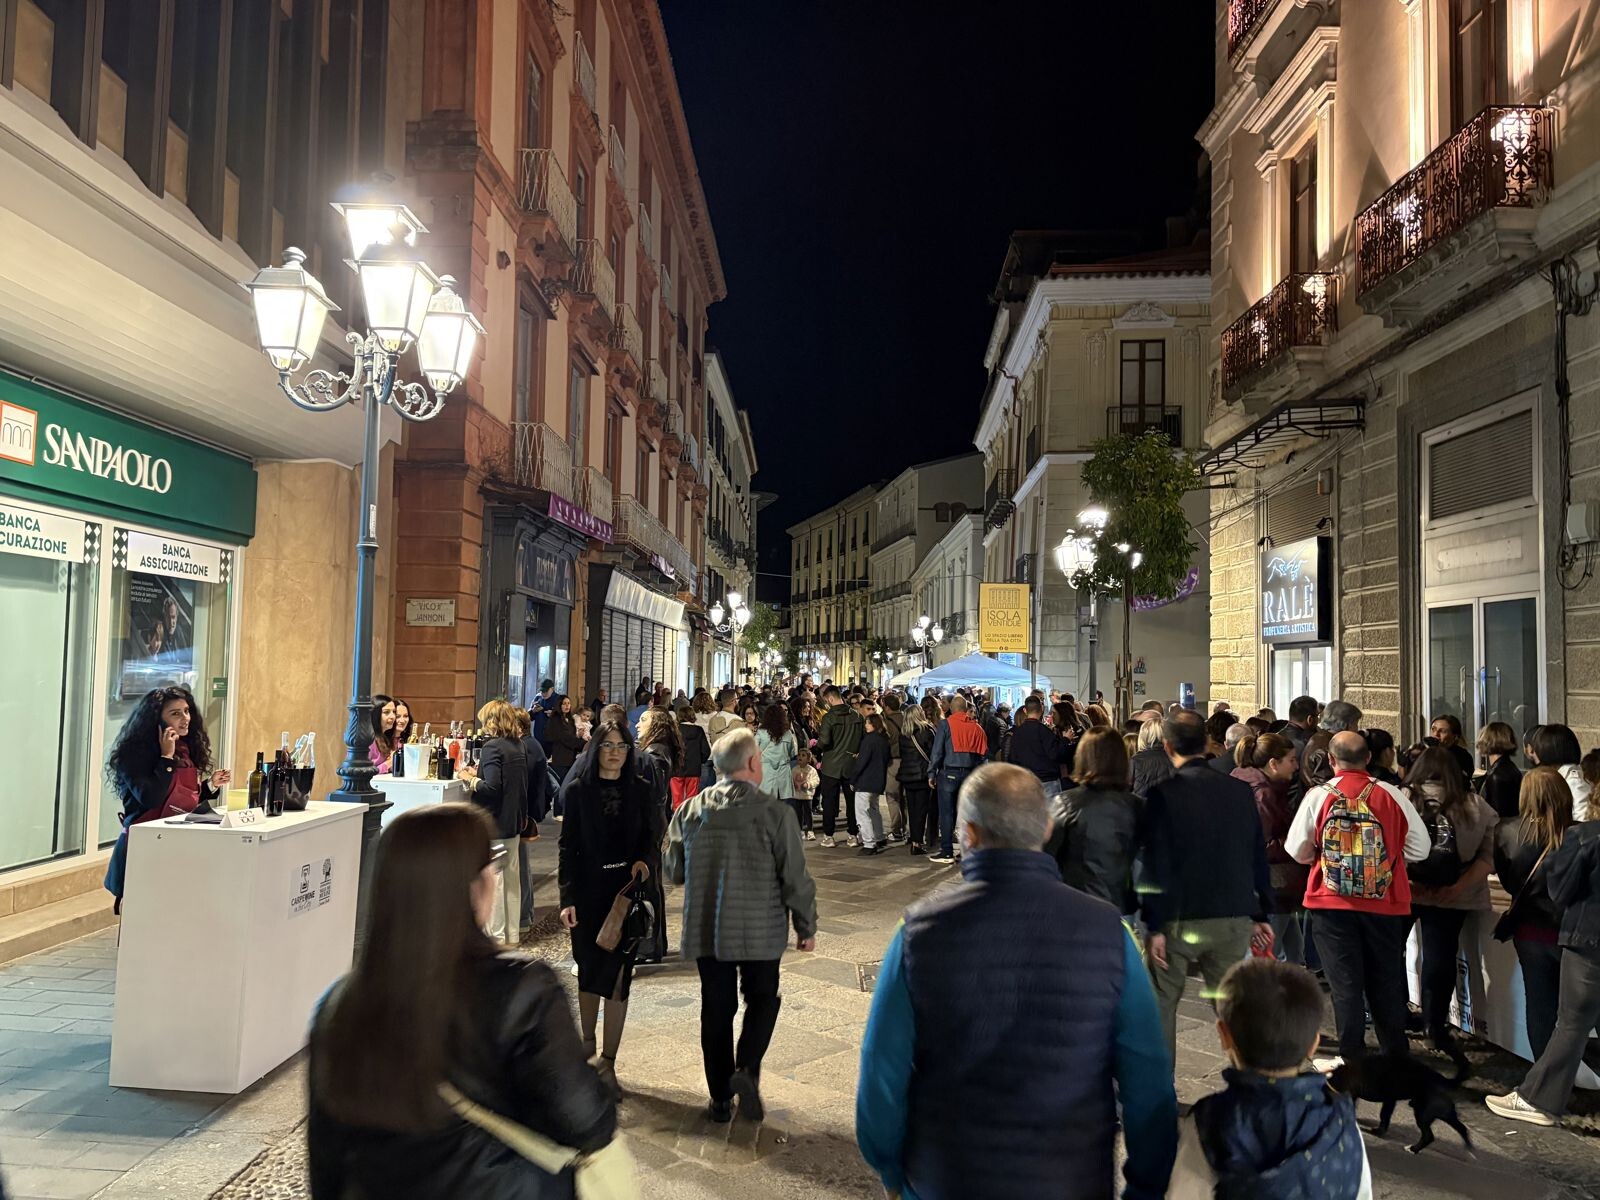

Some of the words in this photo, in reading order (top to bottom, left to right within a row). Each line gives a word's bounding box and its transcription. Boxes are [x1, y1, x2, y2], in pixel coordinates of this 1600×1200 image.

[43, 423, 173, 494] SANPAOLO
[0, 511, 41, 532] BANCA
[162, 543, 191, 559] BANCA
[140, 555, 209, 577] ASSICURAZIONE
[418, 602, 436, 611] VICO
[1262, 575, 1314, 624] RALÈ
[987, 610, 1021, 621] ISOLA
